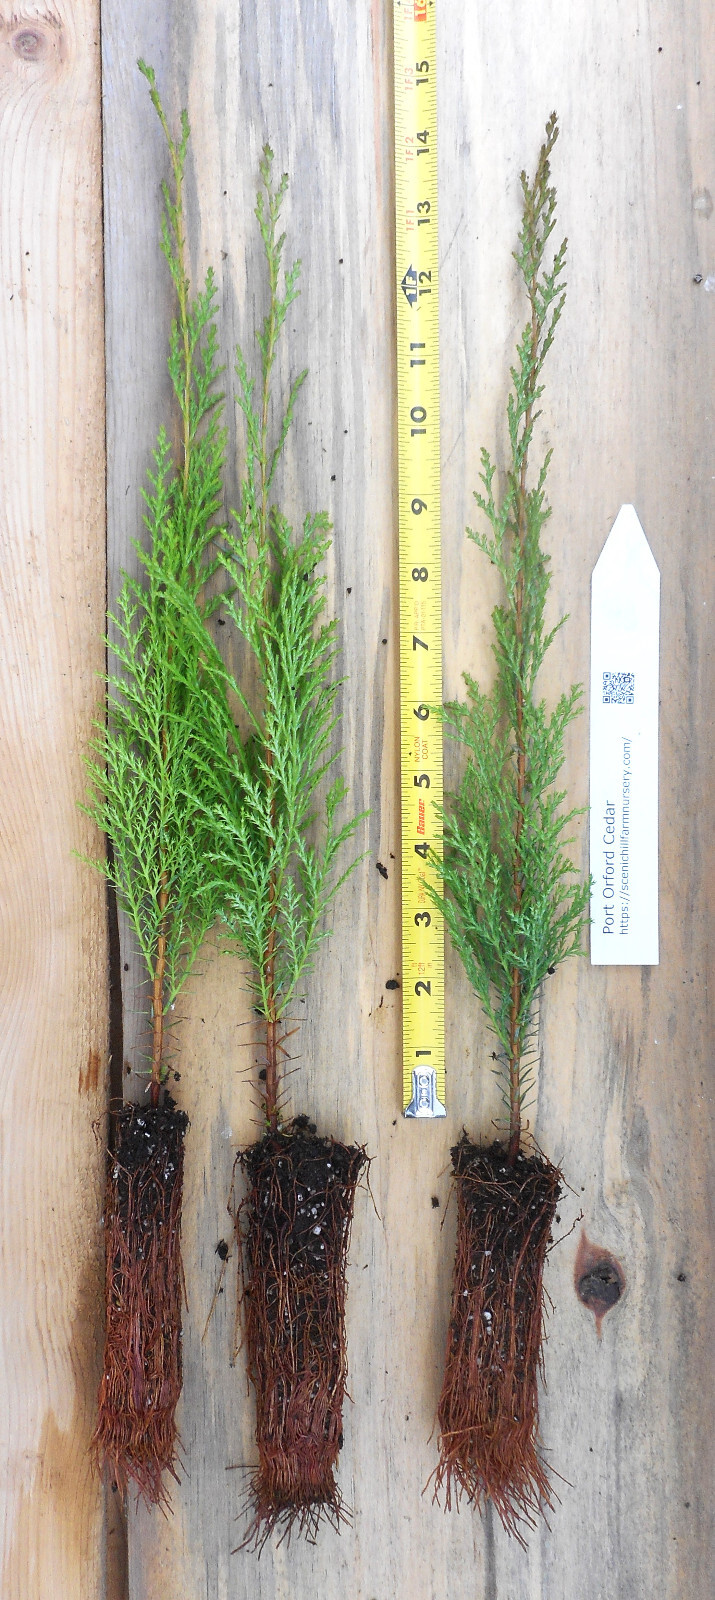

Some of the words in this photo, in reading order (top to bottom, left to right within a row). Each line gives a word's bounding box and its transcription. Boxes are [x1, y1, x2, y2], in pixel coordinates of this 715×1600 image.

[416, 60, 429, 86] 15
[416, 130, 430, 156] 14
[417, 201, 430, 226] 13
[419, 270, 432, 296] 12
[410, 343, 425, 367] 11
[410, 406, 426, 436] 10
[411, 498, 427, 515] 9
[412, 567, 428, 582] 8
[413, 635, 428, 651] 7
[413, 704, 429, 721] 6
[414, 774, 430, 788] 5
[417, 798, 425, 835] Bauer
[603, 800, 615, 844] Cedar
[619, 737, 632, 934] https://scenichillfarmnursery.com/
[414, 842, 430, 859] 4
[603, 851, 614, 898] Orford
[414, 912, 430, 927] 3
[602, 905, 614, 934] Port
[415, 981, 431, 996] 2
